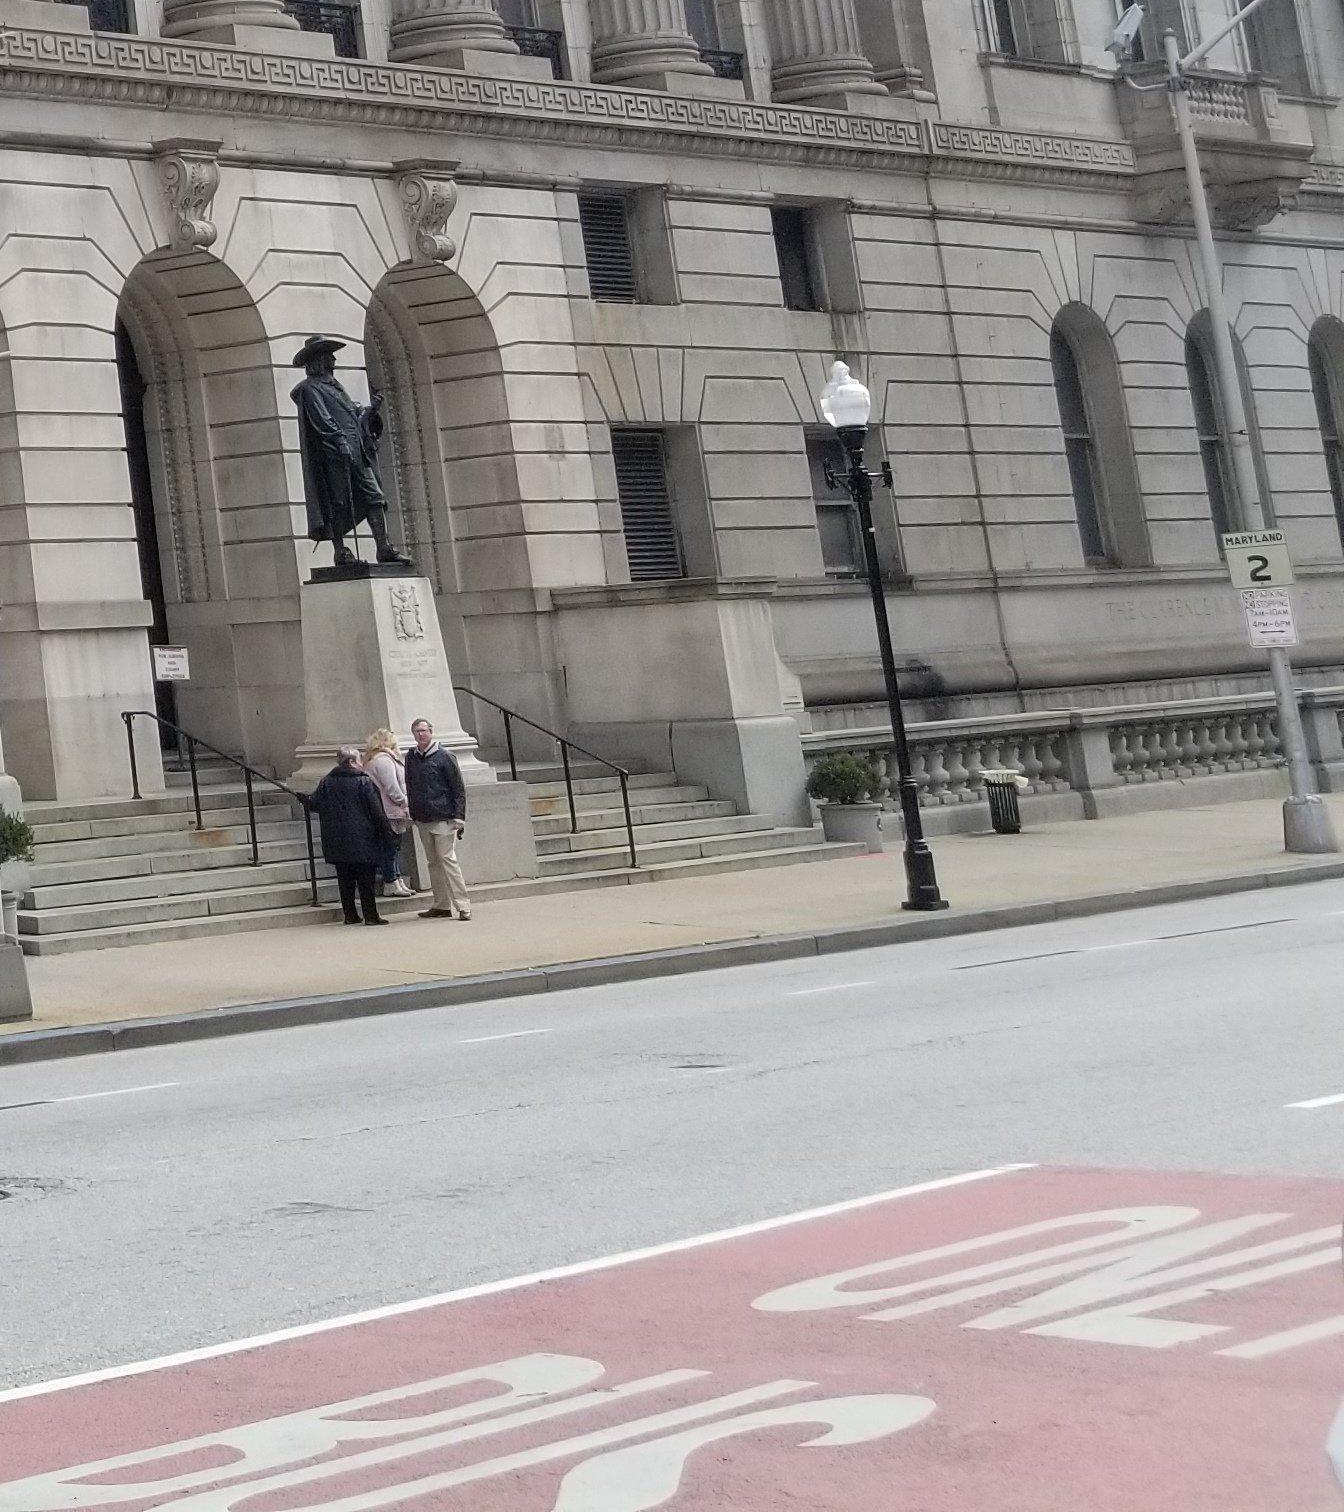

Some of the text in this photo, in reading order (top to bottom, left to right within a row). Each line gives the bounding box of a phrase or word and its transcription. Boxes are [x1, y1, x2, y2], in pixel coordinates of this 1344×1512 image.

[1225, 533, 1283, 546] MARYLAND
[1246, 554, 1272, 582] 2
[749, 1204, 1344, 1358] ONL
